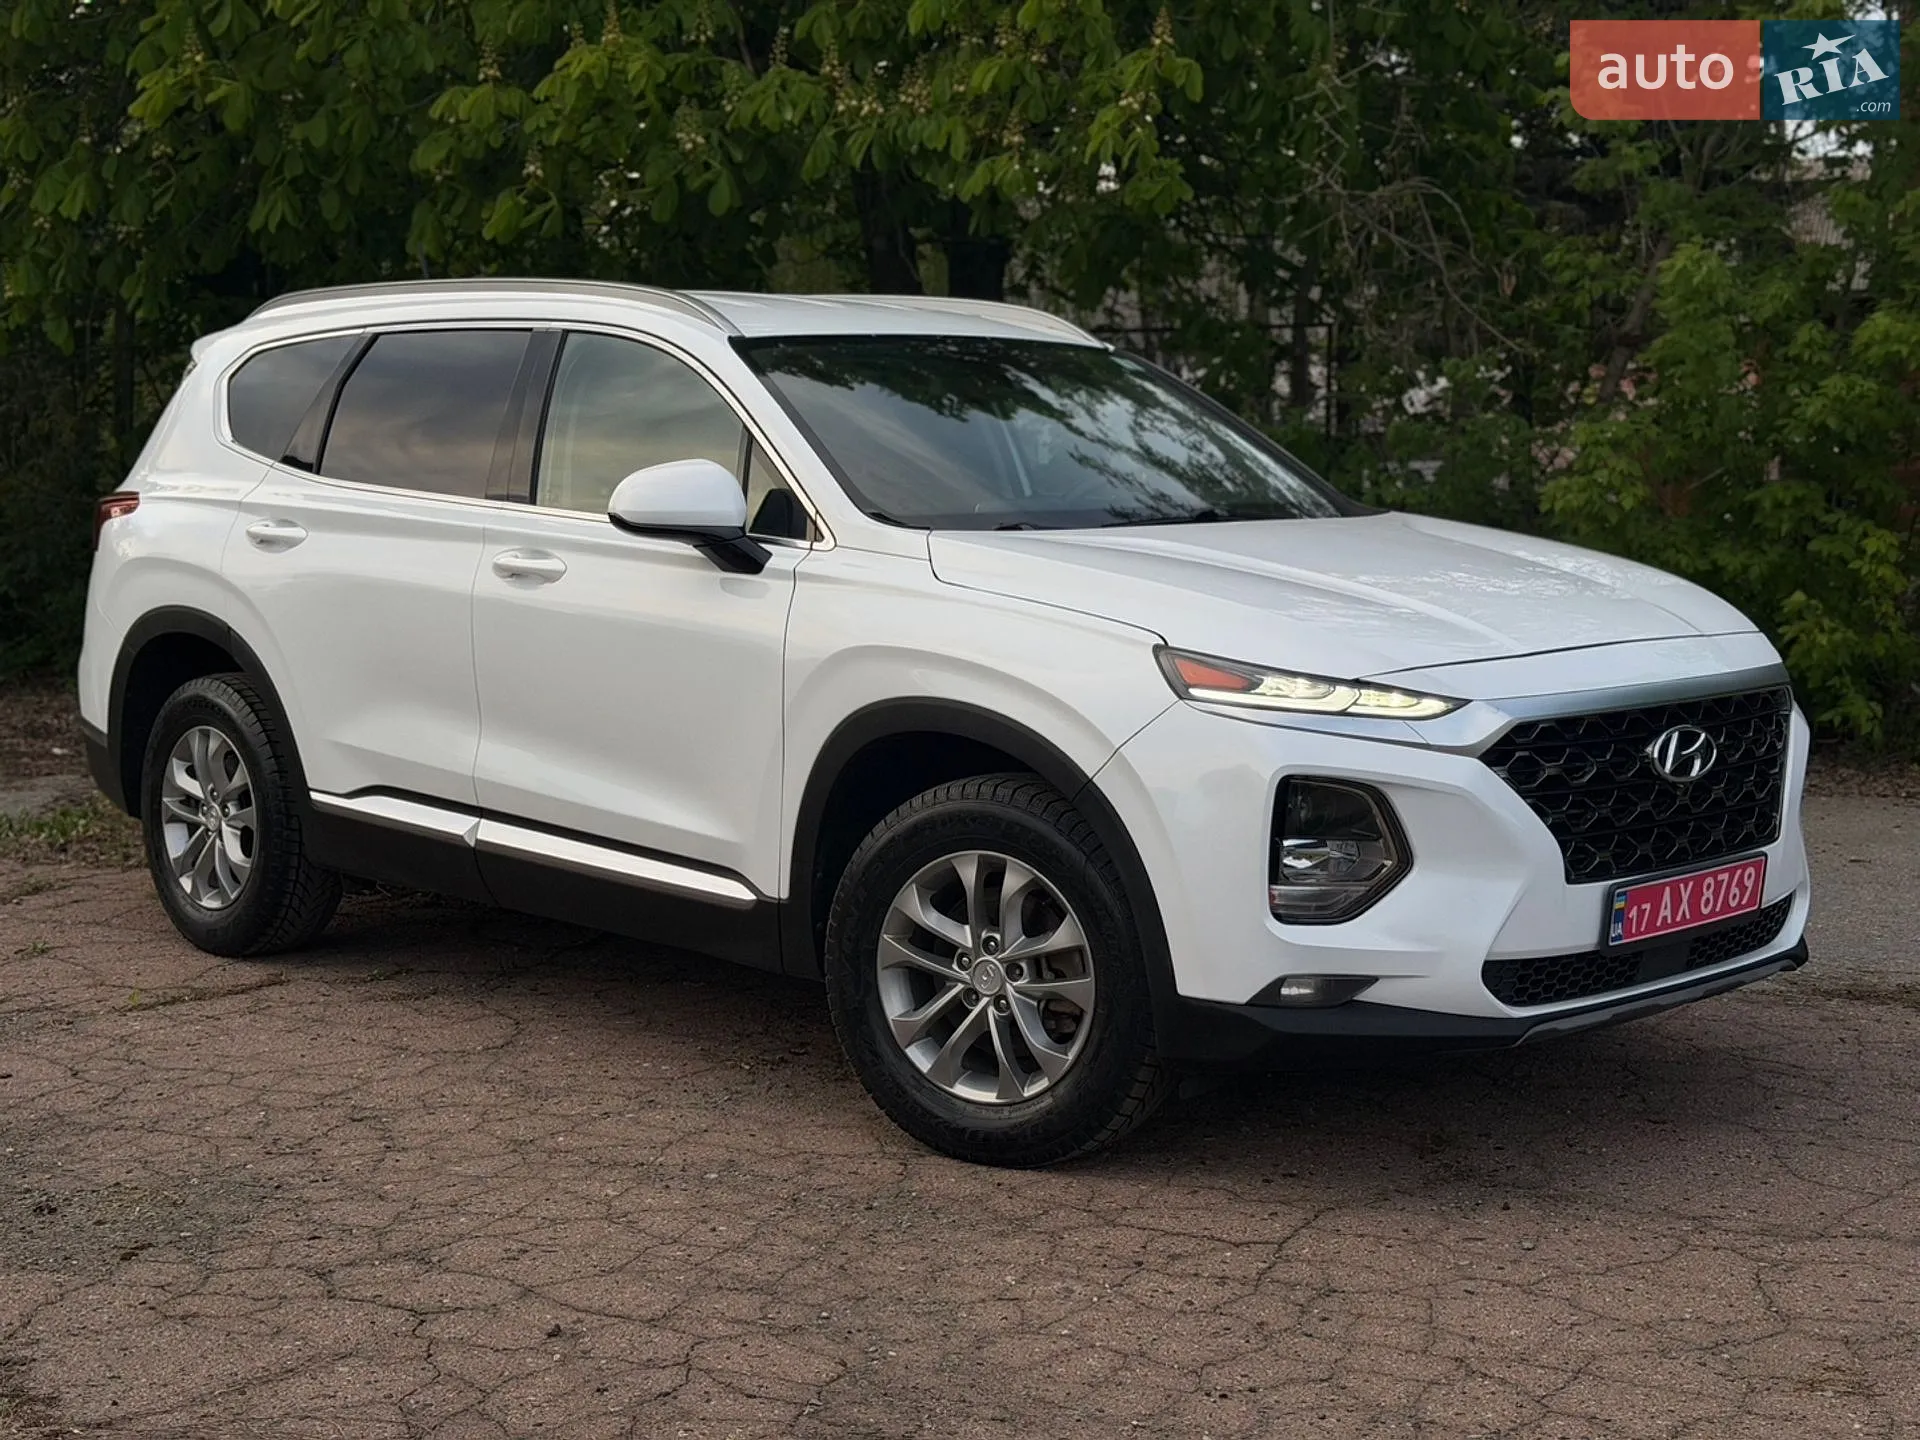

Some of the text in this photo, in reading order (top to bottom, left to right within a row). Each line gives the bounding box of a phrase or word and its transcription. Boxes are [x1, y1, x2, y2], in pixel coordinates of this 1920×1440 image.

[1628, 866, 1756, 934] 17 AX 8769
[1611, 922, 1623, 937] UA
